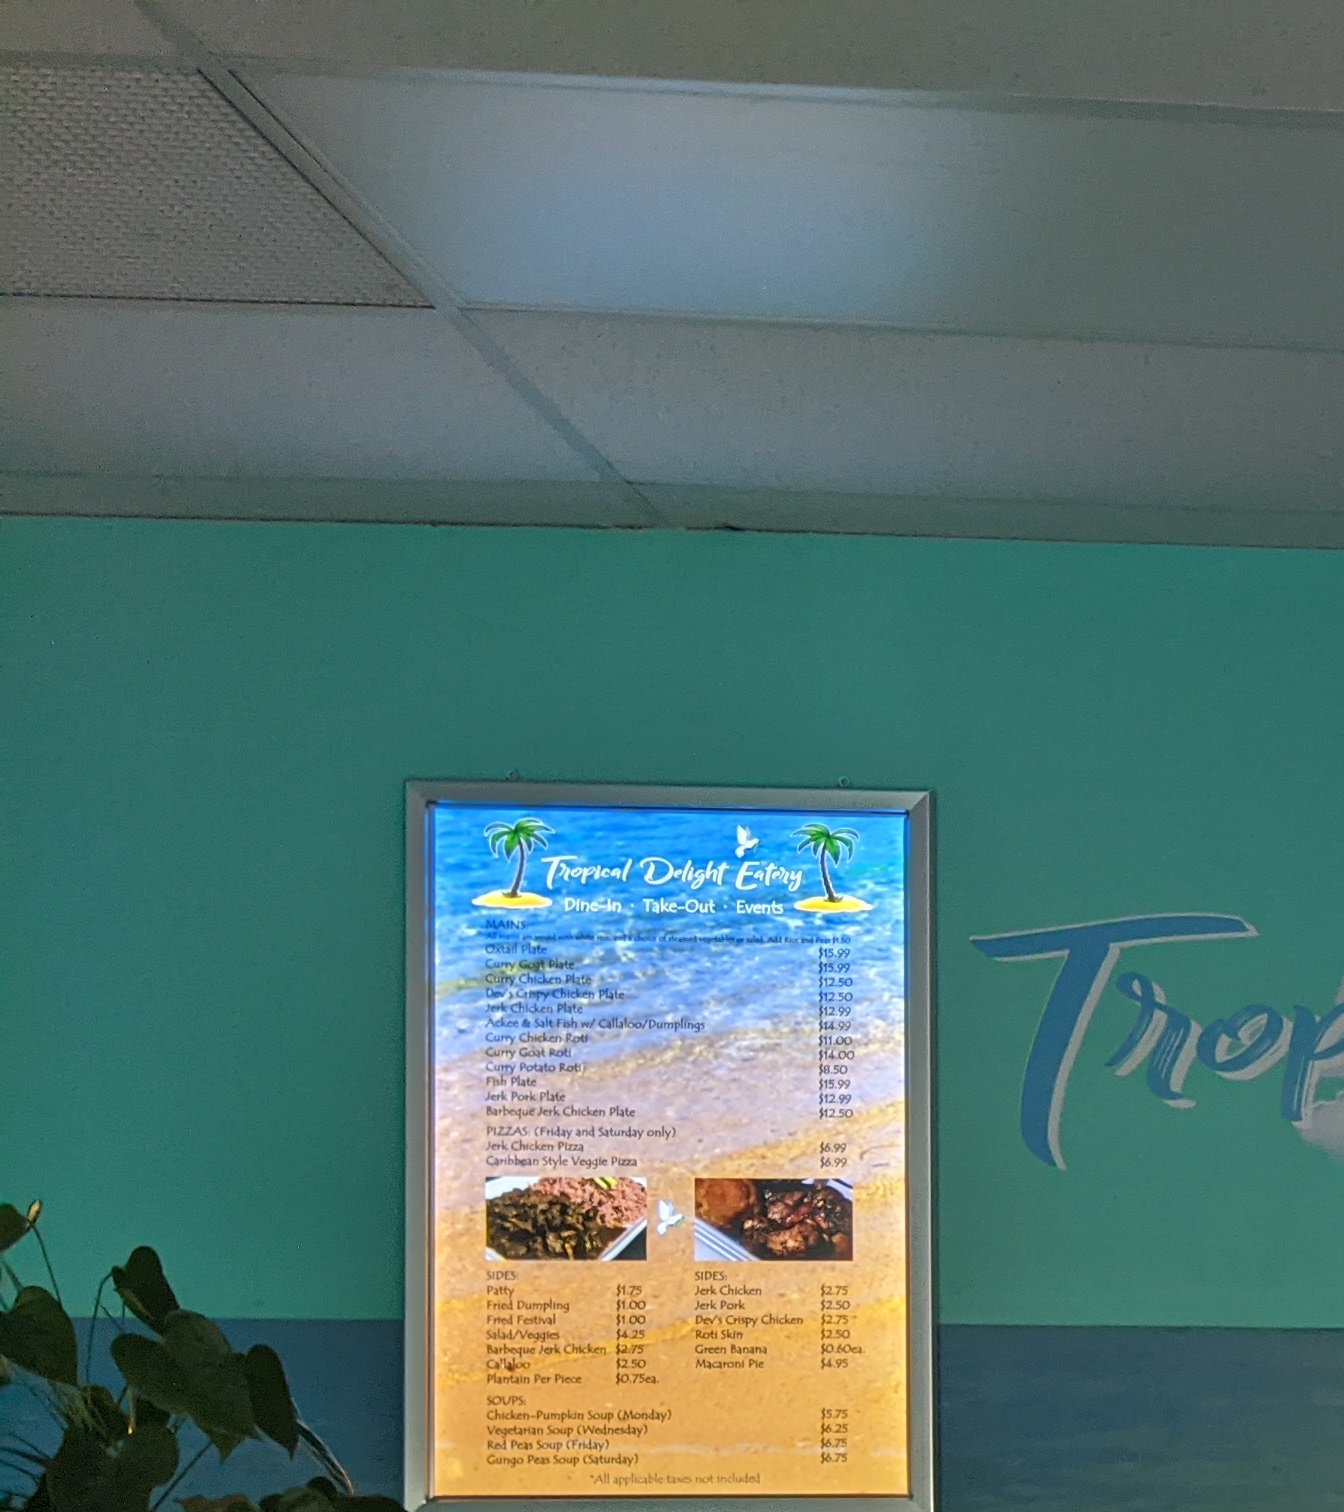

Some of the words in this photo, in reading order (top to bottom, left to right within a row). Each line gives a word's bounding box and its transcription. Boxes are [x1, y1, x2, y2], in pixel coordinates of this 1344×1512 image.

[541, 854, 632, 889] Tropical
[640, 856, 729, 889] Delight
[734, 860, 803, 891] Eatery
[565, 898, 622, 914] Dine-In
[642, 900, 715, 915] Take-Out
[736, 900, 783, 915] Events
[521, 940, 550, 955] Plate
[818, 946, 851, 960] $15.99
[484, 1002, 509, 1014] Jerk
[509, 1001, 554, 1014] Chicken
[556, 1002, 584, 1014] Plate
[818, 1004, 852, 1019] $12.99
[484, 1017, 519, 1029] Ackee
[521, 1018, 531, 1029] &
[534, 1016, 555, 1029] Salt
[555, 1017, 578, 1029] Fish
[580, 1018, 597, 1029] w/
[597, 1016, 706, 1034] Callaloo/Dumplings
[818, 1018, 852, 1033] $14.99
[484, 1046, 516, 1060] Curry
[518, 1047, 546, 1059] Goat
[818, 1047, 856, 1063] $14.00
[533, 1125, 573, 1140] (Friday
[575, 1125, 596, 1138] and
[597, 1126, 645, 1141] Saturday
[646, 1125, 677, 1141] only)
[485, 1154, 540, 1167] Caribbean
[541, 1154, 569, 1171] Style
[570, 1155, 608, 1170] Veggie
[610, 1156, 638, 1168] Pizza
[819, 1155, 848, 1170] $6.99
[485, 1328, 561, 1343] Salad/Veggies
[615, 1327, 646, 1342] $4.25
[820, 1356, 849, 1371] $4.95
[486, 1408, 585, 1423] Chicken-Pumpkin
[616, 1408, 672, 1423] (Monday)
[820, 1407, 849, 1421] $5.75
[486, 1453, 525, 1469] Gungo
[526, 1454, 551, 1466] Peas
[582, 1453, 639, 1468] (Saturday)
[820, 1451, 848, 1465] $6.75
